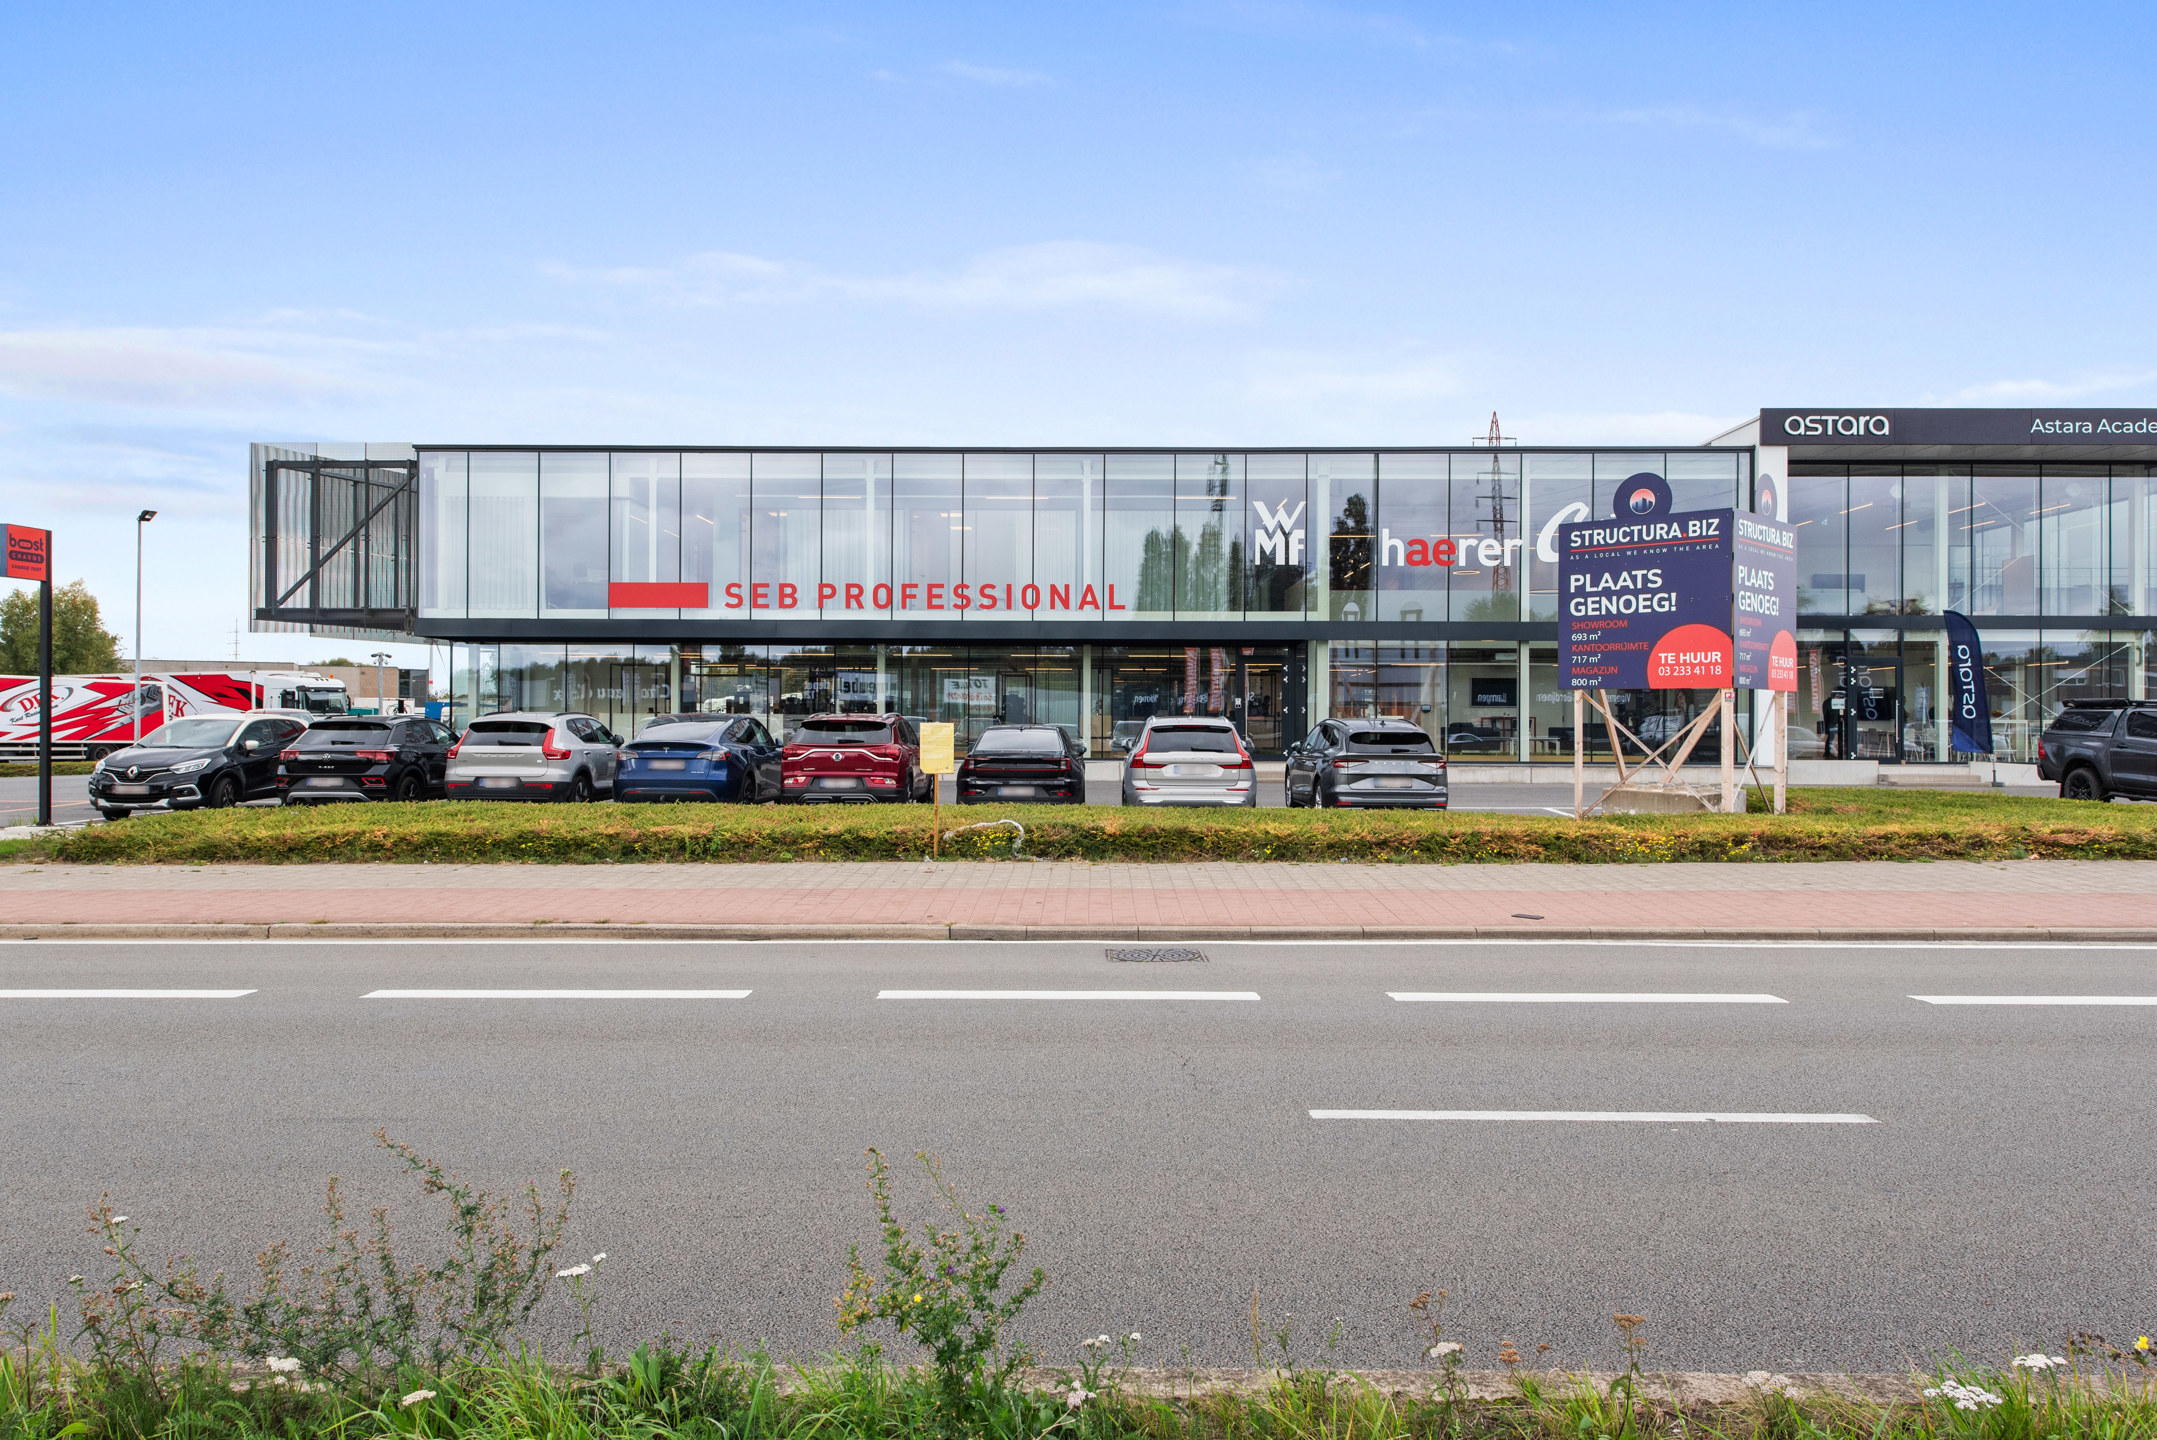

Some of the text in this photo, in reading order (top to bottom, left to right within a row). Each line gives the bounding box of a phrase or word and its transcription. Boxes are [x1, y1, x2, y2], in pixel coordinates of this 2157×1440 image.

[1783, 415, 1890, 436] astara
[2030, 418, 2157, 434] Astara Acade
[1252, 500, 1306, 566] WMF
[1570, 518, 1720, 547] STRUCTURA.BIZ
[1382, 528, 1523, 567] haerer
[1570, 569, 1663, 593] PLAATS
[1738, 565, 1774, 590] PLAATS
[725, 582, 1126, 611] SEB PROFESSIONAL
[1570, 593, 1677, 616] GENOEG!
[1738, 590, 1779, 616] GENOEG!
[1571, 620, 1628, 630] SHOWROOM
[1572, 633, 1587, 641] 693
[1571, 642, 1649, 653] KANTOORRUIMTE
[1572, 656, 1588, 664] 717
[1659, 651, 1722, 664] TE HUUR
[1772, 656, 1793, 668] TE HUUR
[1571, 666, 1619, 675] MAGAZIJN
[1658, 665, 1722, 676] 03 233 41 18
[1571, 678, 1588, 687] 800
